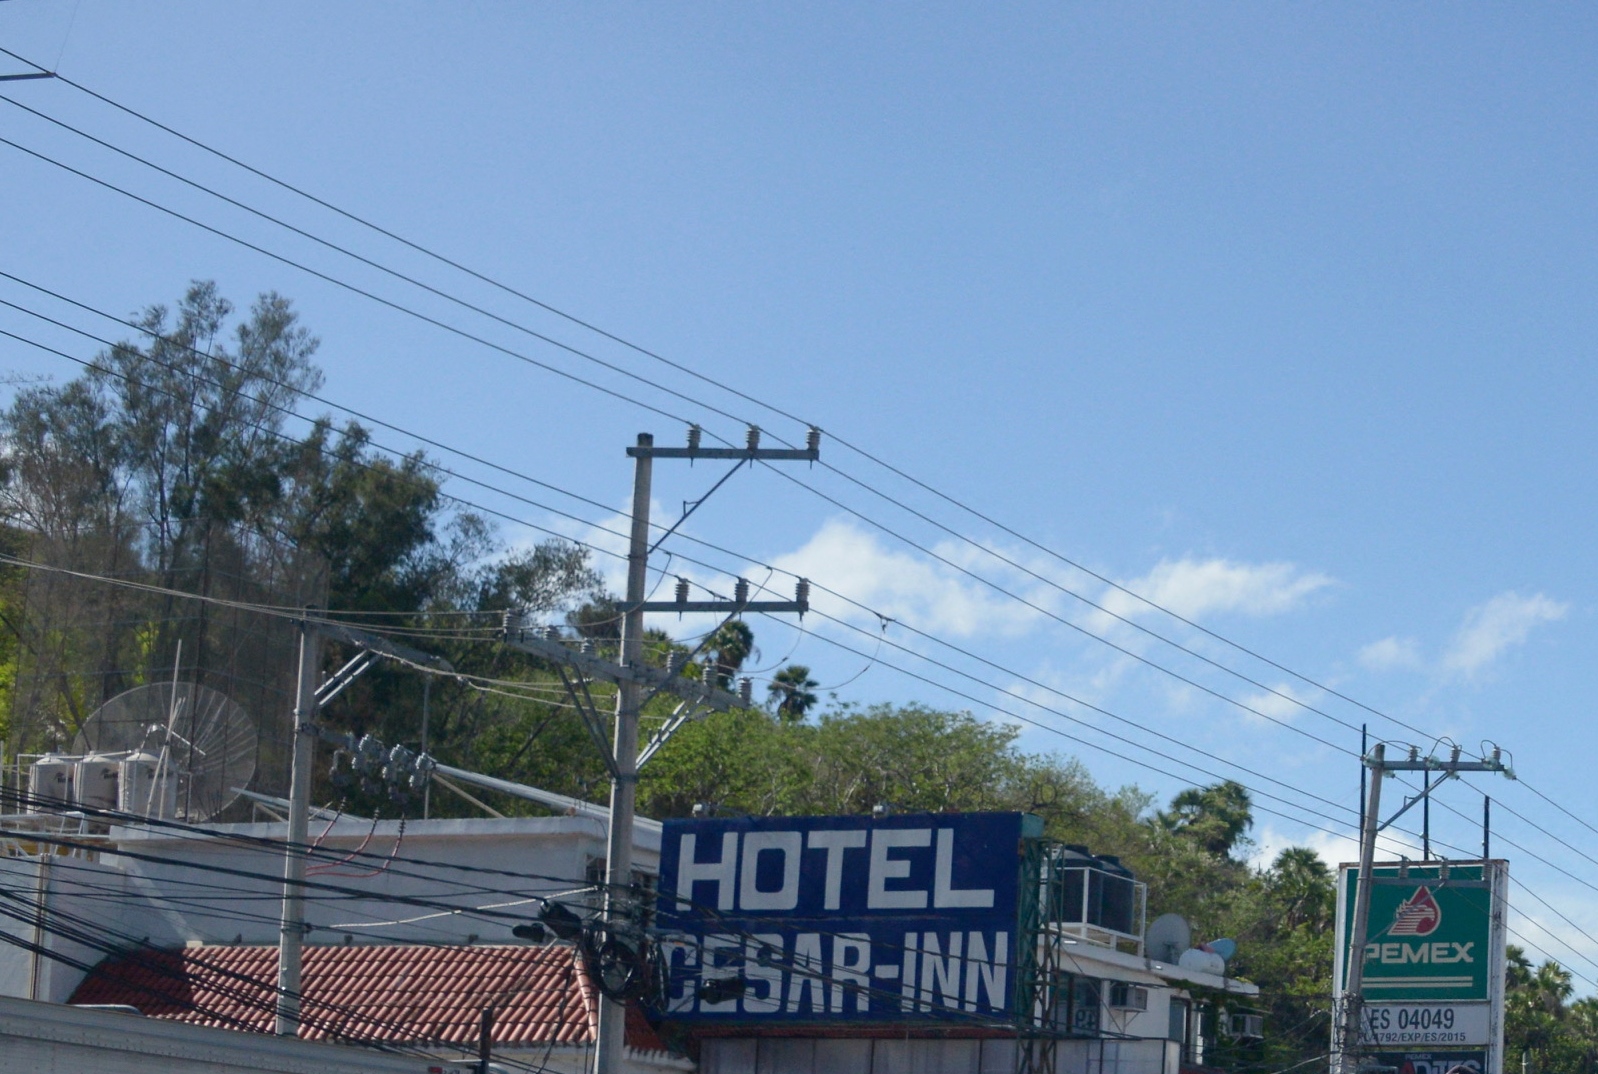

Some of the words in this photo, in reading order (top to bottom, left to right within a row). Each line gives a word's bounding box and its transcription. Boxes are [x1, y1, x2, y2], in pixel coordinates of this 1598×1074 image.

[676, 828, 995, 911] HOTEL
[663, 931, 1008, 1014] CESAR-INN
[1363, 942, 1474, 964] PEMEX
[1370, 1008, 1391, 1030] ES
[1398, 1008, 1455, 1030] 04049
